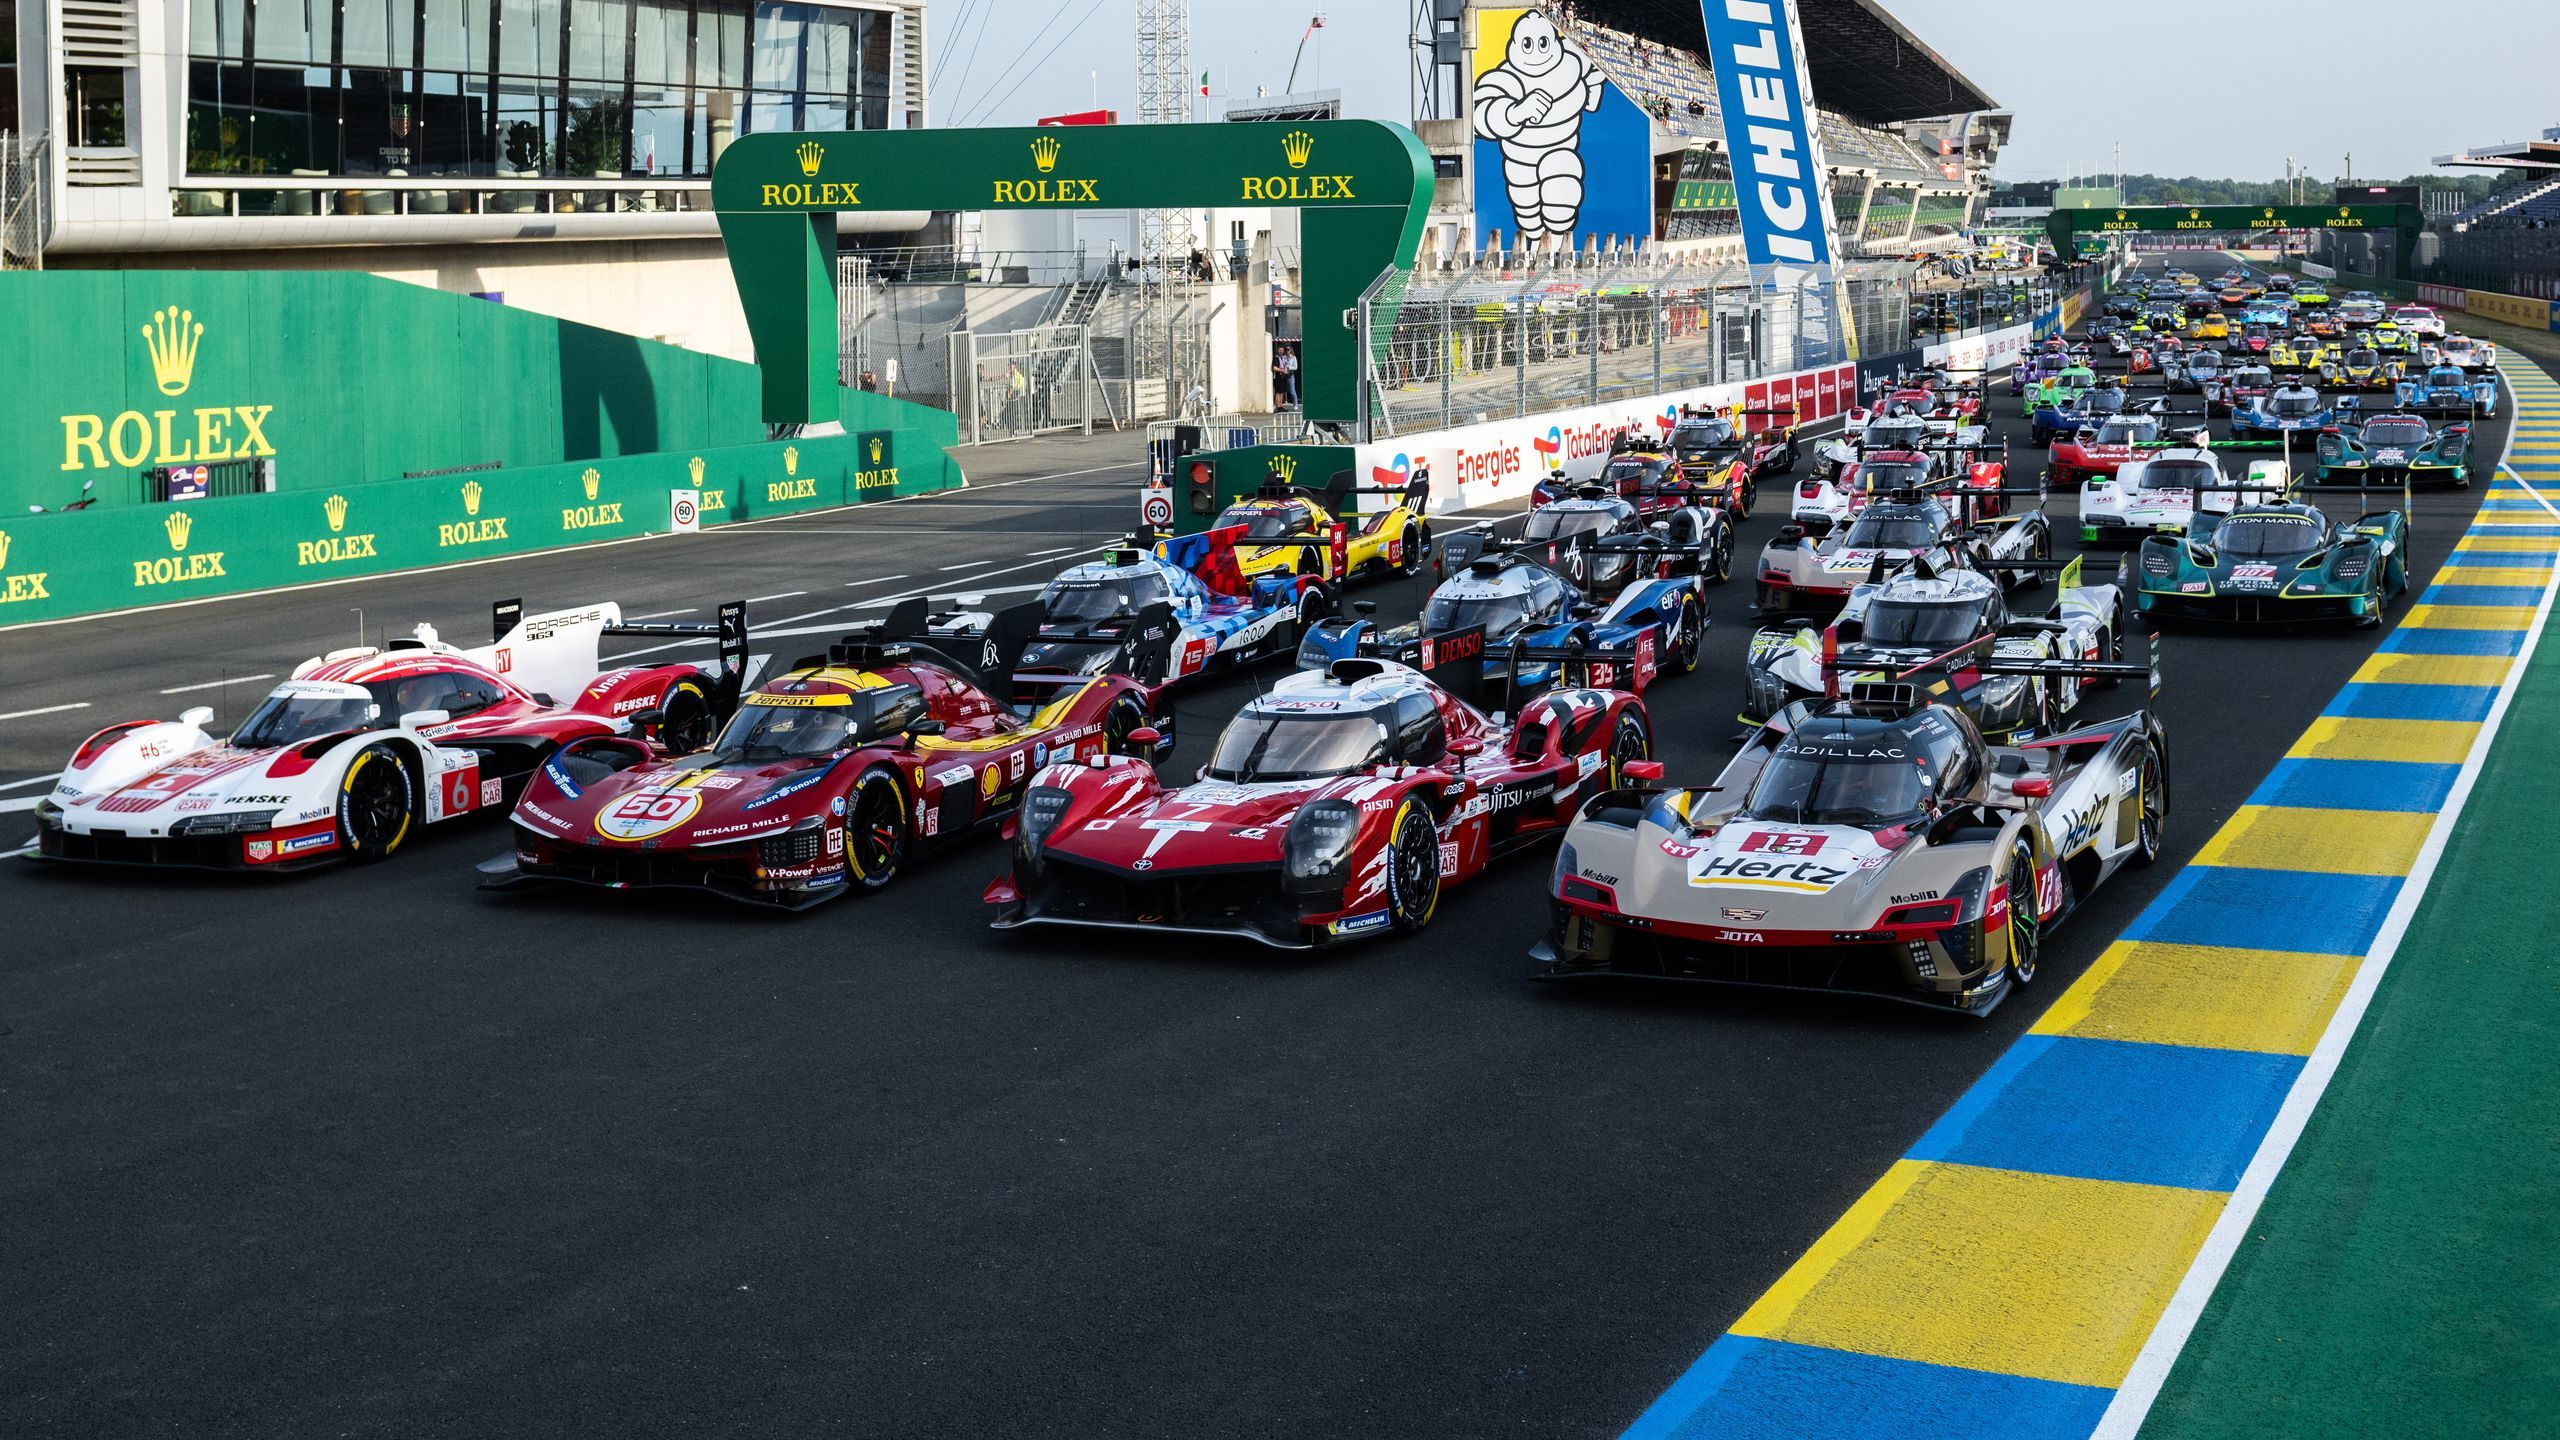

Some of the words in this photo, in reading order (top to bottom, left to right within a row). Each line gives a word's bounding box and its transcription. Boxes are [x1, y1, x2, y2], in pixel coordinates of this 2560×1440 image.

[761, 183, 861, 206] ROLEX
[993, 179, 1100, 203] ROLEX
[1241, 175, 1356, 201] ROLEX
[2103, 221, 2139, 230] ROLEX
[2176, 220, 2213, 229] ROLEX
[2251, 219, 2287, 228] ROLEX
[2326, 218, 2363, 227] ROLEX
[60, 405, 276, 471] ROLEX
[854, 467, 900, 490] ROLEX
[767, 478, 816, 502] ROLEX
[562, 502, 624, 531] ROLEX
[678, 505, 691, 517] 60
[1148, 505, 1167, 518] 60
[2226, 518, 2263, 526] ASTON
[2265, 518, 2313, 527] MARTIN
[439, 517, 509, 547] ROLEX
[1334, 530, 1342, 544] HY
[297, 534, 377, 566] ROLEX
[1391, 543, 1400, 559] 83
[133, 552, 226, 586] ROLEX
[2232, 568, 2273, 576] 007
[1661, 592, 1674, 610] elf
[526, 610, 601, 632] PORSCHE
[721, 607, 739, 618] Ansys
[526, 630, 554, 642] 963
[722, 638, 737, 649] Mobil
[1205, 645, 1217, 656] CAR
[1422, 640, 1434, 665] HY
[1439, 632, 1481, 664] DENSO
[1639, 637, 1654, 654] JFE
[1752, 644, 1790, 652] yahoo!
[1993, 648, 2033, 657] ahoo!
[496, 649, 510, 673] HY
[1185, 649, 1203, 665] 15
[1945, 650, 1976, 674] CADILLAC
[588, 669, 631, 700] Ansys
[613, 694, 657, 715] PENSKE
[753, 694, 816, 706] Ferrari
[1266, 698, 1335, 709] DENSO
[1054, 725, 1082, 745] RICHARD
[1082, 722, 1102, 737] MILLE
[139, 742, 160, 760] #6
[1034, 743, 1047, 768] hp
[1053, 744, 1072, 761] WEC
[1582, 751, 1600, 767] WEC
[1776, 743, 1906, 758] CADILLAC
[146, 775, 179, 789] 6
[482, 778, 501, 790] HYPER
[545, 764, 559, 784] ADLER
[561, 782, 579, 799] GROUP
[864, 770, 890, 782] MICHELIN
[223, 794, 292, 804] PENSKE
[452, 772, 469, 809] 6
[482, 788, 501, 805] CAR
[747, 792, 779, 809] ADLER
[790, 775, 821, 792] GROUP
[618, 795, 683, 818] 50
[833, 798, 845, 816] hp
[1362, 798, 1394, 812] AISIN
[1488, 788, 1522, 815] UJITSU
[300, 808, 323, 821] Mobil
[524, 800, 553, 822] RICHARD
[549, 815, 574, 830] MILLE
[1172, 803, 1213, 819] 7
[693, 822, 749, 837] RICHARD
[751, 813, 790, 828] MILLE
[2061, 792, 2110, 854] Hertz
[250, 841, 272, 849] TAG
[294, 834, 330, 847] MICHELIN
[1469, 820, 1481, 864] 7
[1662, 839, 1700, 857] HY
[1754, 835, 1812, 856] 12
[1438, 844, 1457, 856] YPER
[767, 866, 813, 878] V-Power
[1440, 857, 1456, 873] AR
[1697, 856, 1847, 885] Hertz
[808, 875, 842, 888] MICHELIN
[1389, 850, 1400, 901] MICHELIN
[1582, 868, 1610, 883] Mobil
[1890, 891, 1926, 904] Mobil
[1926, 890, 1938, 899] 1
[2038, 868, 2054, 915] 12
[1348, 914, 1385, 928] MICHELIN
[1715, 930, 1764, 943] JOTA
